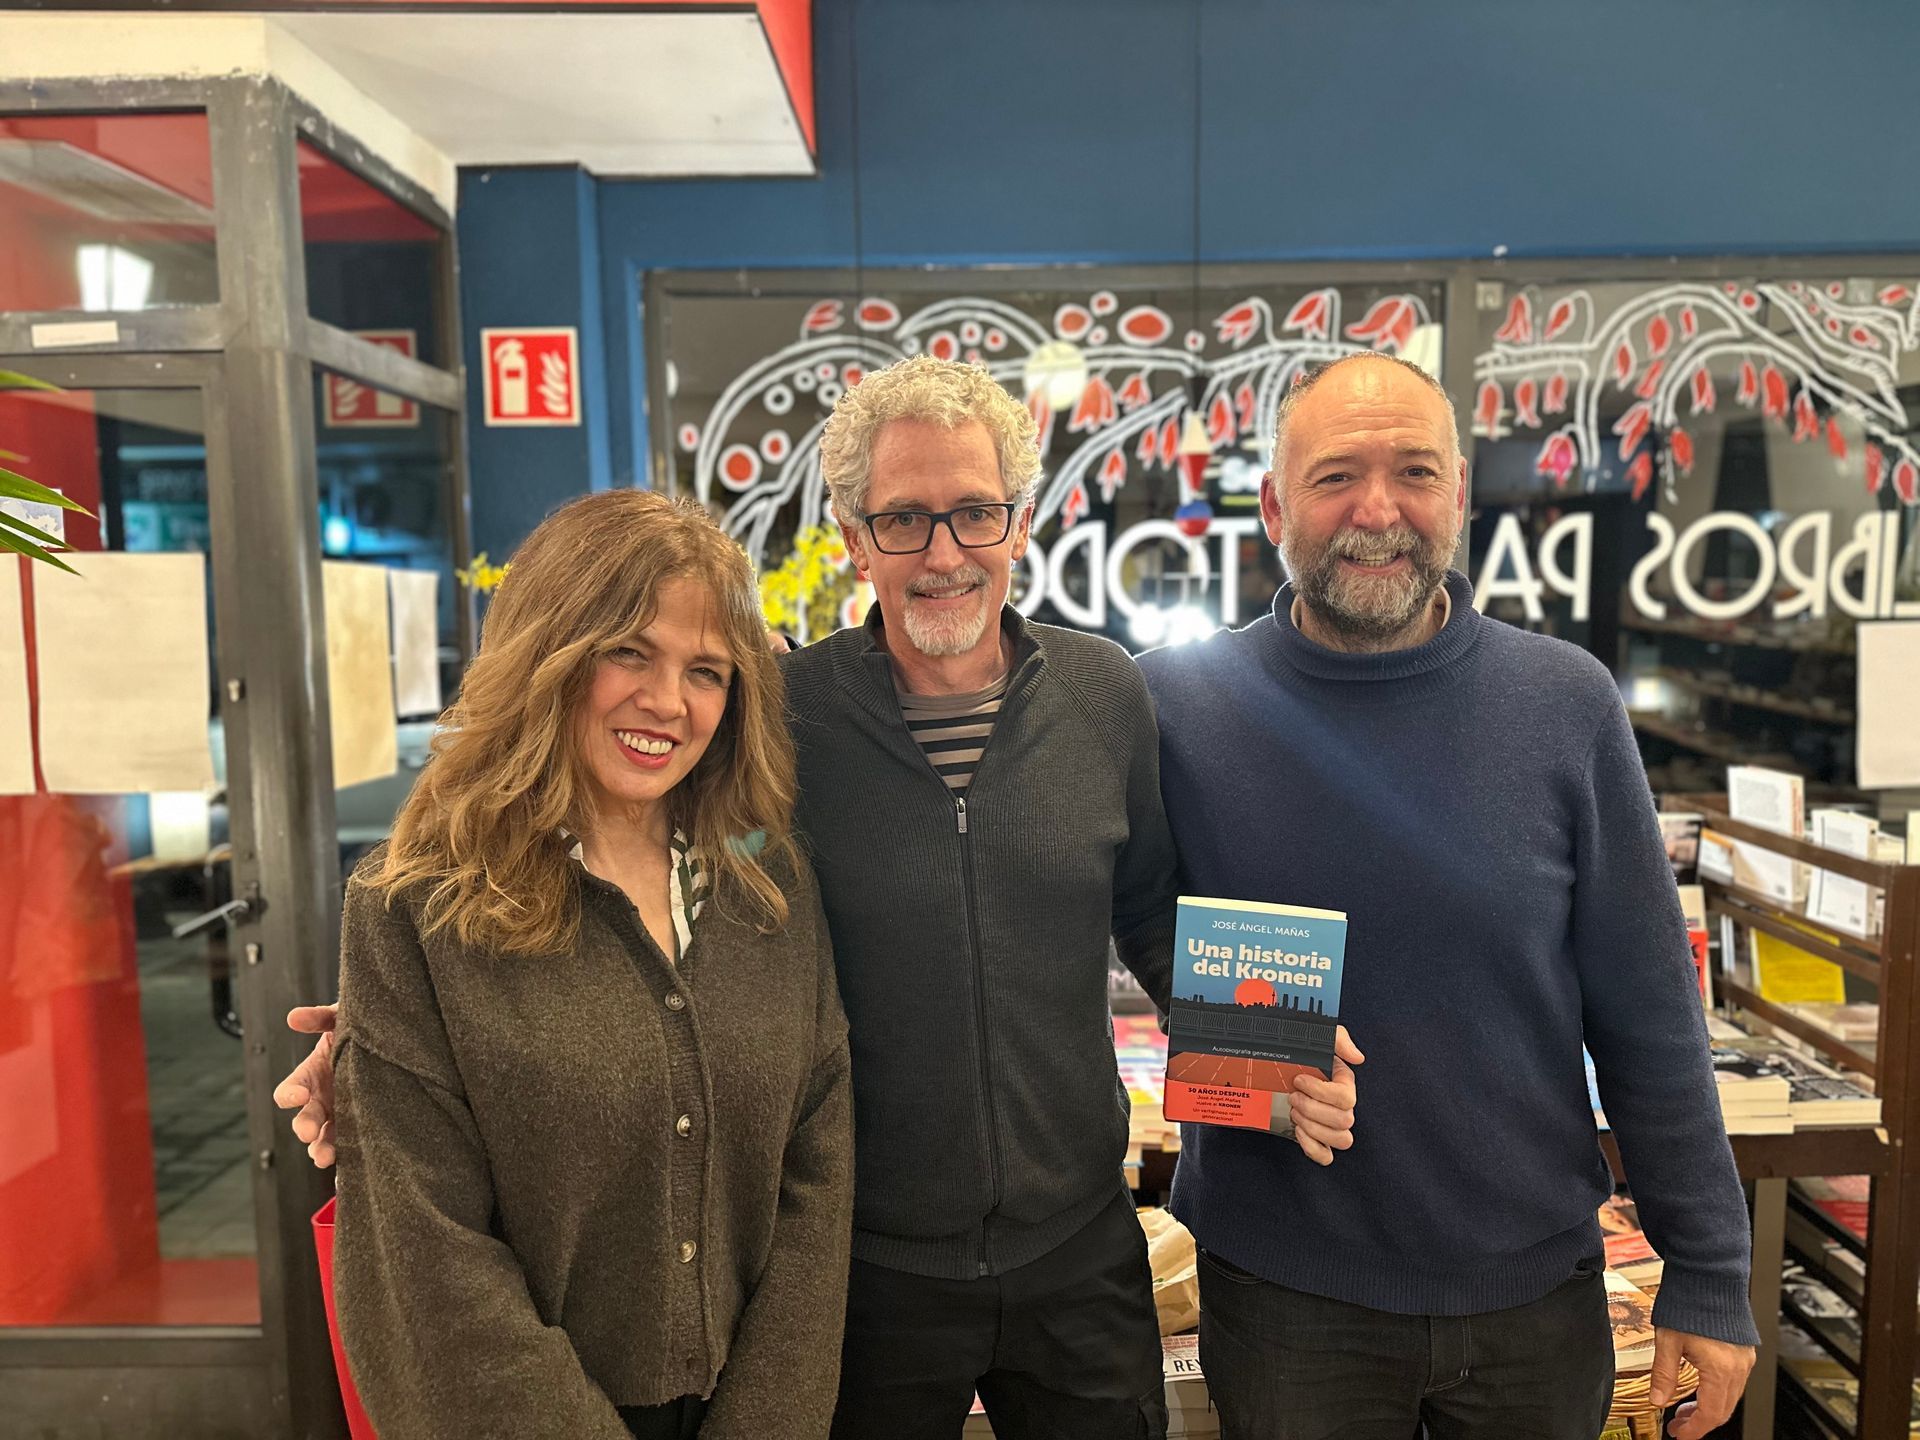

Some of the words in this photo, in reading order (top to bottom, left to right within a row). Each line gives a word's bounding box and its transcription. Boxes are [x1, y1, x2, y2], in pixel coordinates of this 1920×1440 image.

[1212, 920, 1237, 931] JOSÉ
[1238, 922, 1272, 934] ÁNGEL
[1274, 926, 1310, 938] MAÑAS
[1188, 938, 1233, 959] Una
[1239, 943, 1332, 970] historia
[1192, 958, 1230, 978] del
[1235, 961, 1323, 988] Kronen
[1252, 1049, 1291, 1060] generacional
[1198, 1087, 1218, 1095] AÑOS
[1219, 1090, 1250, 1098] DESPUÉS
